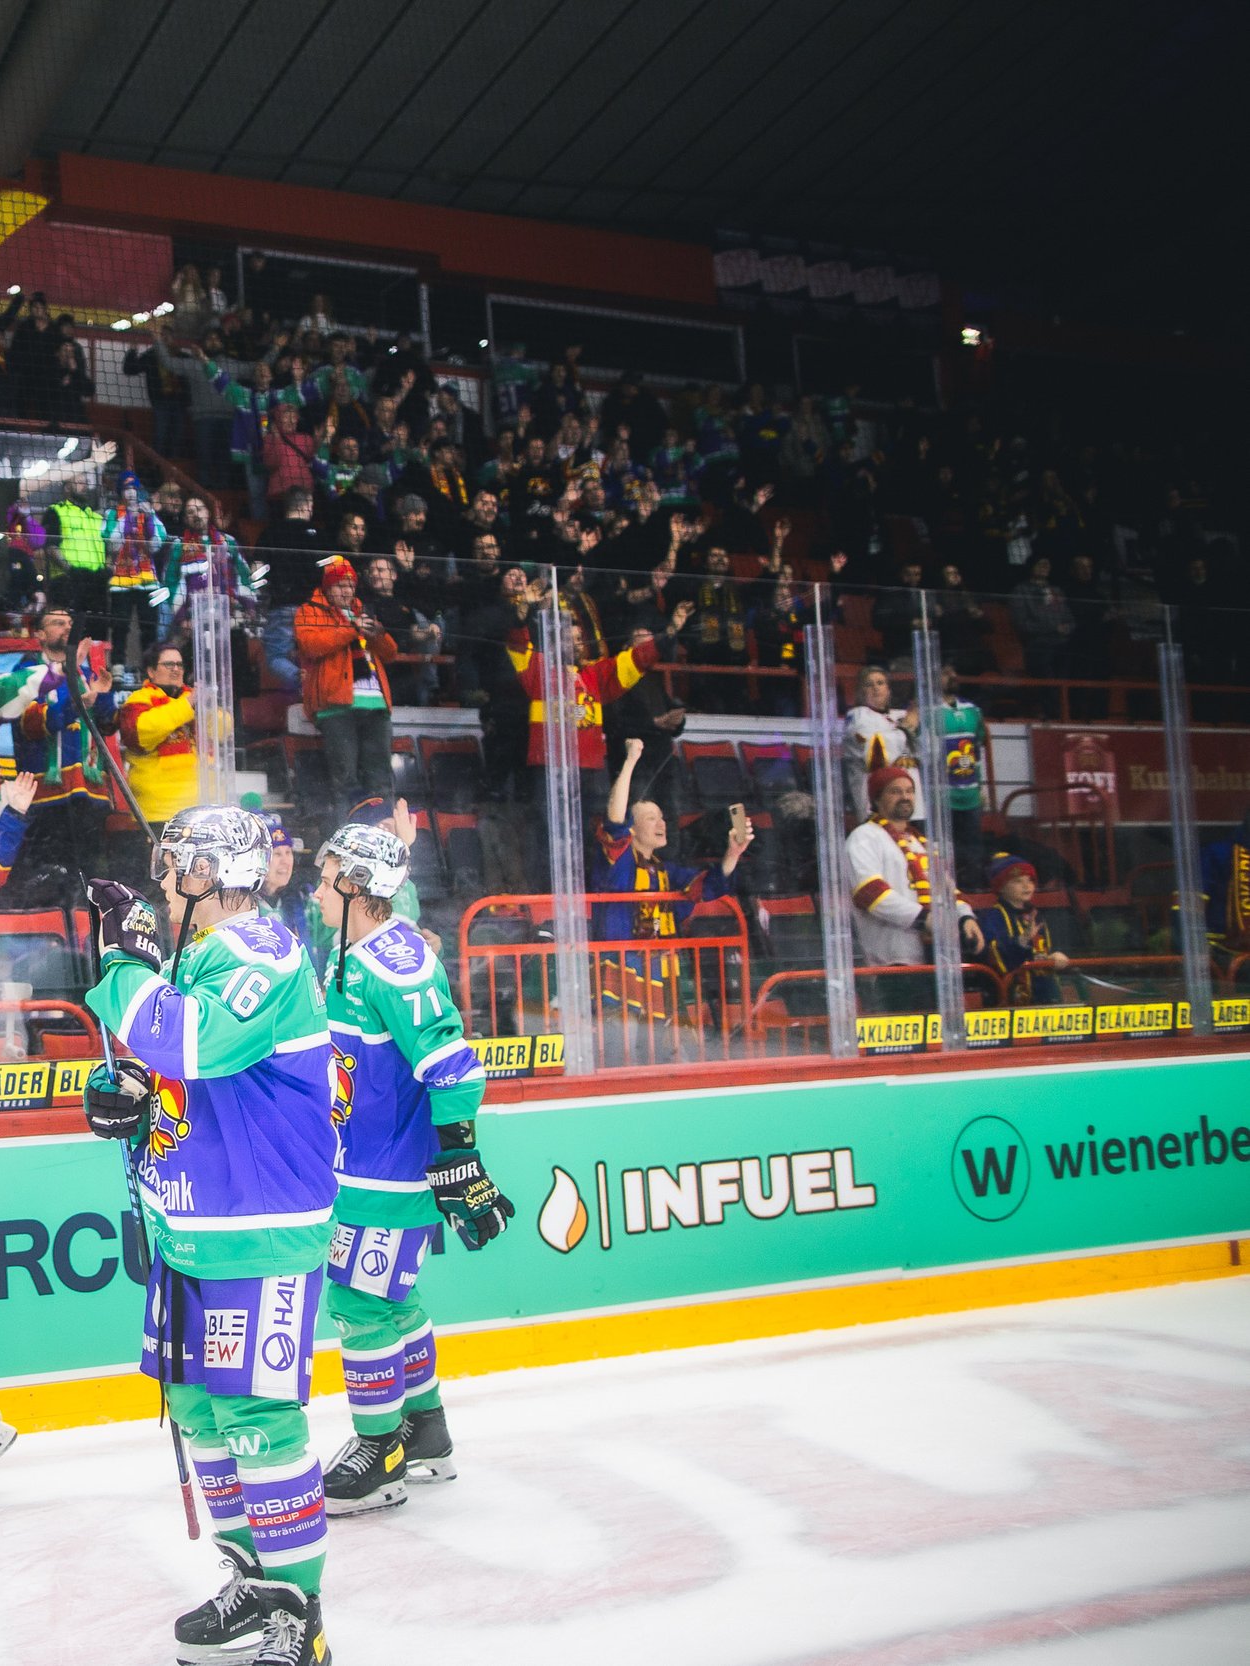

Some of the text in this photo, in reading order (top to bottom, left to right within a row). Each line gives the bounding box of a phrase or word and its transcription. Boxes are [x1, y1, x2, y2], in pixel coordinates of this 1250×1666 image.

[219, 966, 272, 1019] 16
[401, 986, 443, 1027] 71
[622, 1148, 877, 1234] INFUEL
[962, 1145, 1018, 1197] W
[273, 1275, 297, 1326] HAL
[227, 1434, 261, 1457] W
[256, 1511, 300, 1526] GROUP
[269, 1514, 322, 1537] Brändillesi
